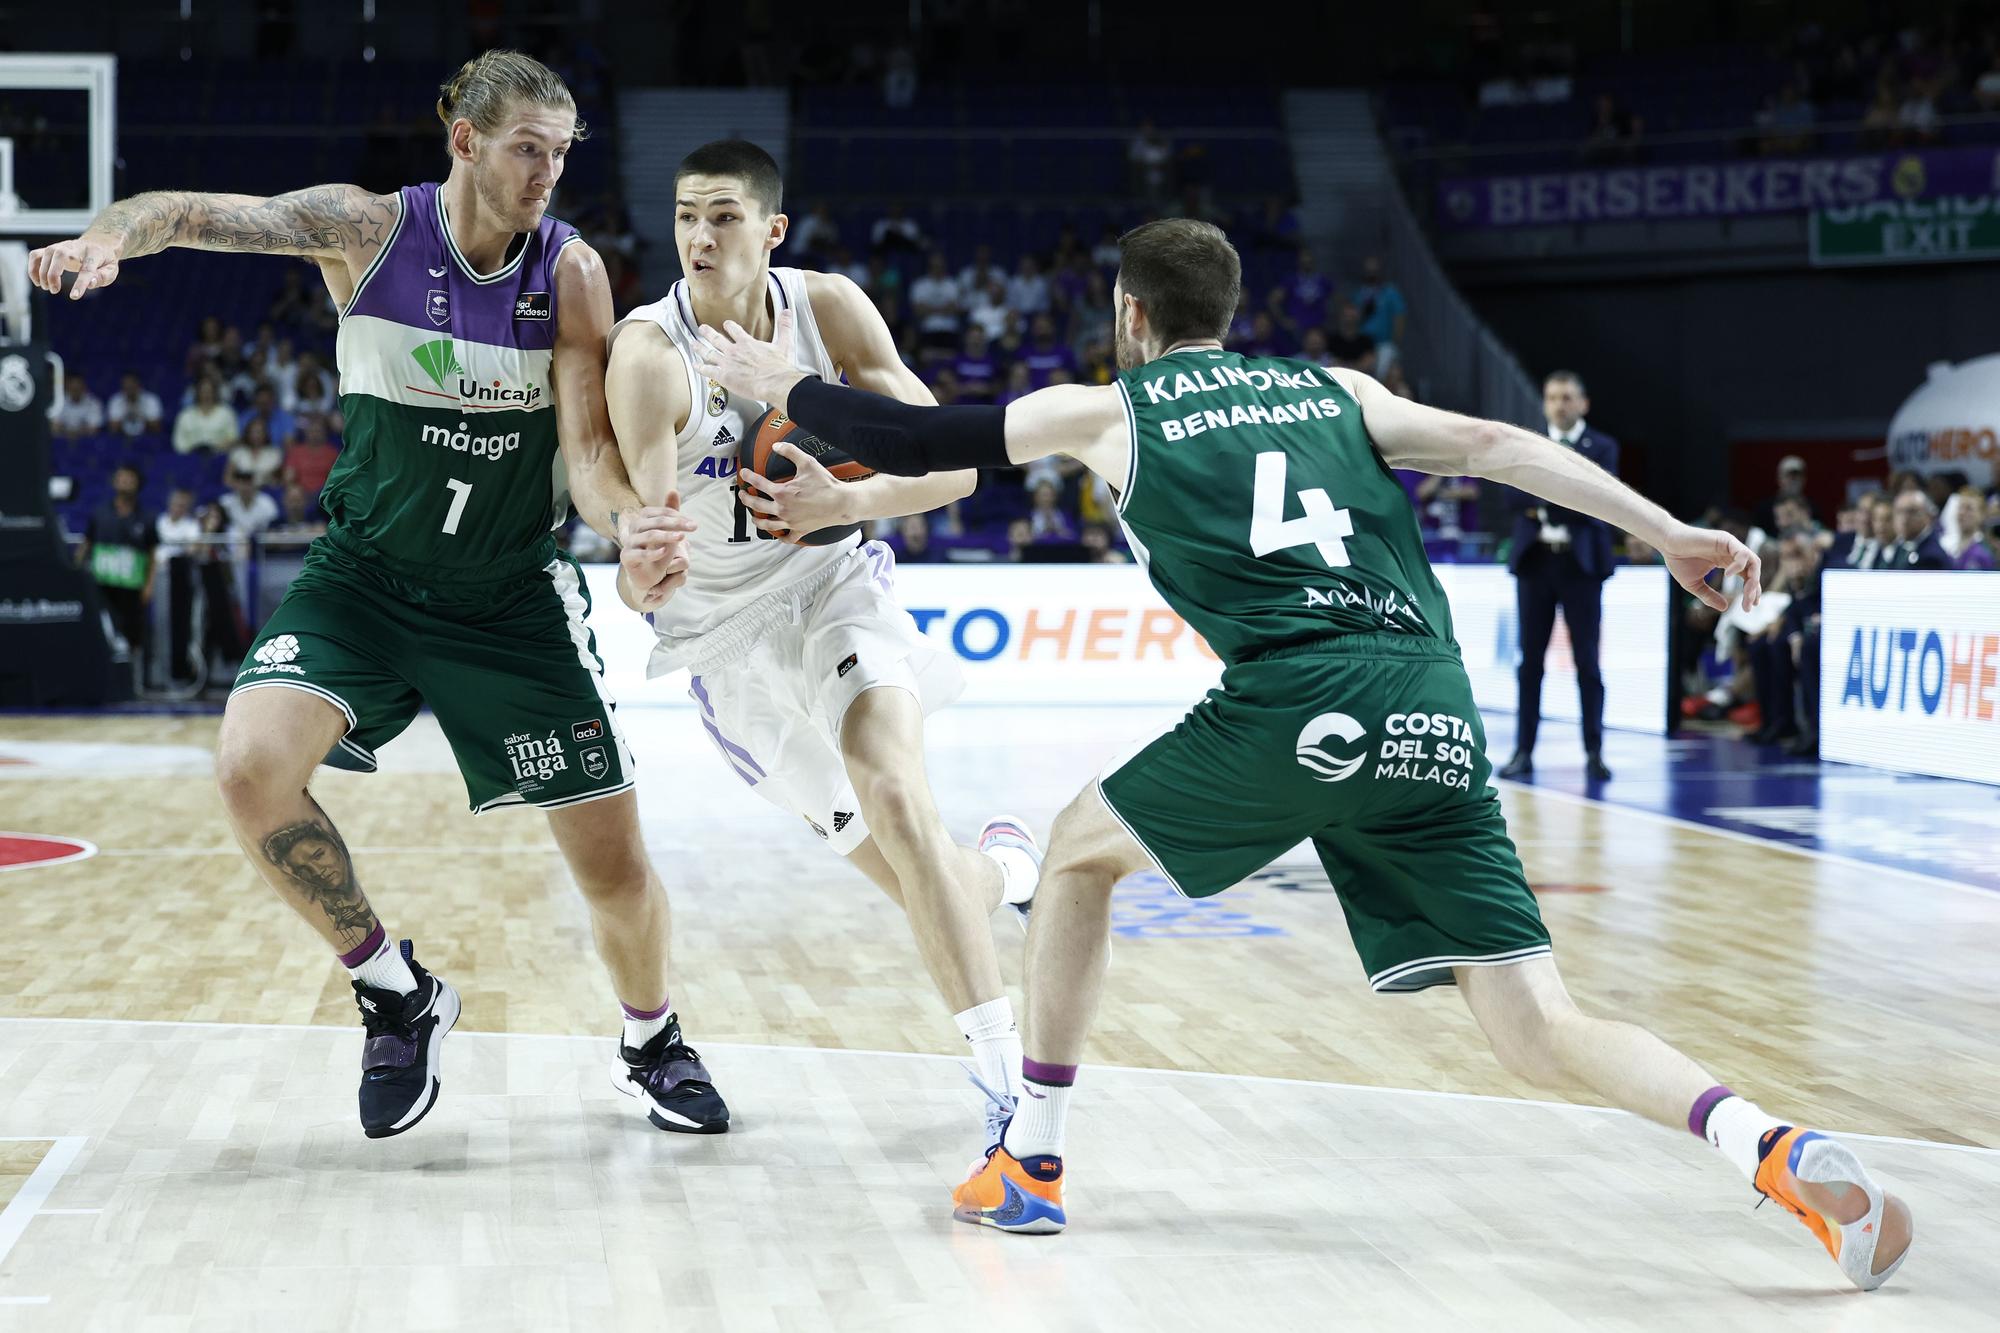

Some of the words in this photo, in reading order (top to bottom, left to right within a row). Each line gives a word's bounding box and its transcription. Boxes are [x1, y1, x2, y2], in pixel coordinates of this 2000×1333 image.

[1490, 157, 1881, 225] BERSERKERS
[1881, 220, 1976, 254] EXIT
[459, 378, 542, 406] Unicaja
[1142, 364, 1324, 405] KALINOSKI
[1160, 397, 1343, 442] BENAHAVÍS
[712, 435, 736, 446] adidas
[441, 477, 473, 536] 1
[1249, 451, 1355, 568] 4
[503, 732, 531, 746] sabor
[516, 729, 565, 761] má
[576, 727, 597, 739] acb
[1385, 712, 1475, 747] COSTA
[509, 755, 569, 780] laga
[1380, 740, 1428, 759] DEL
[1433, 742, 1474, 770] SOL
[1374, 759, 1471, 792] MÁLAGA
[835, 811, 855, 832] adidas
